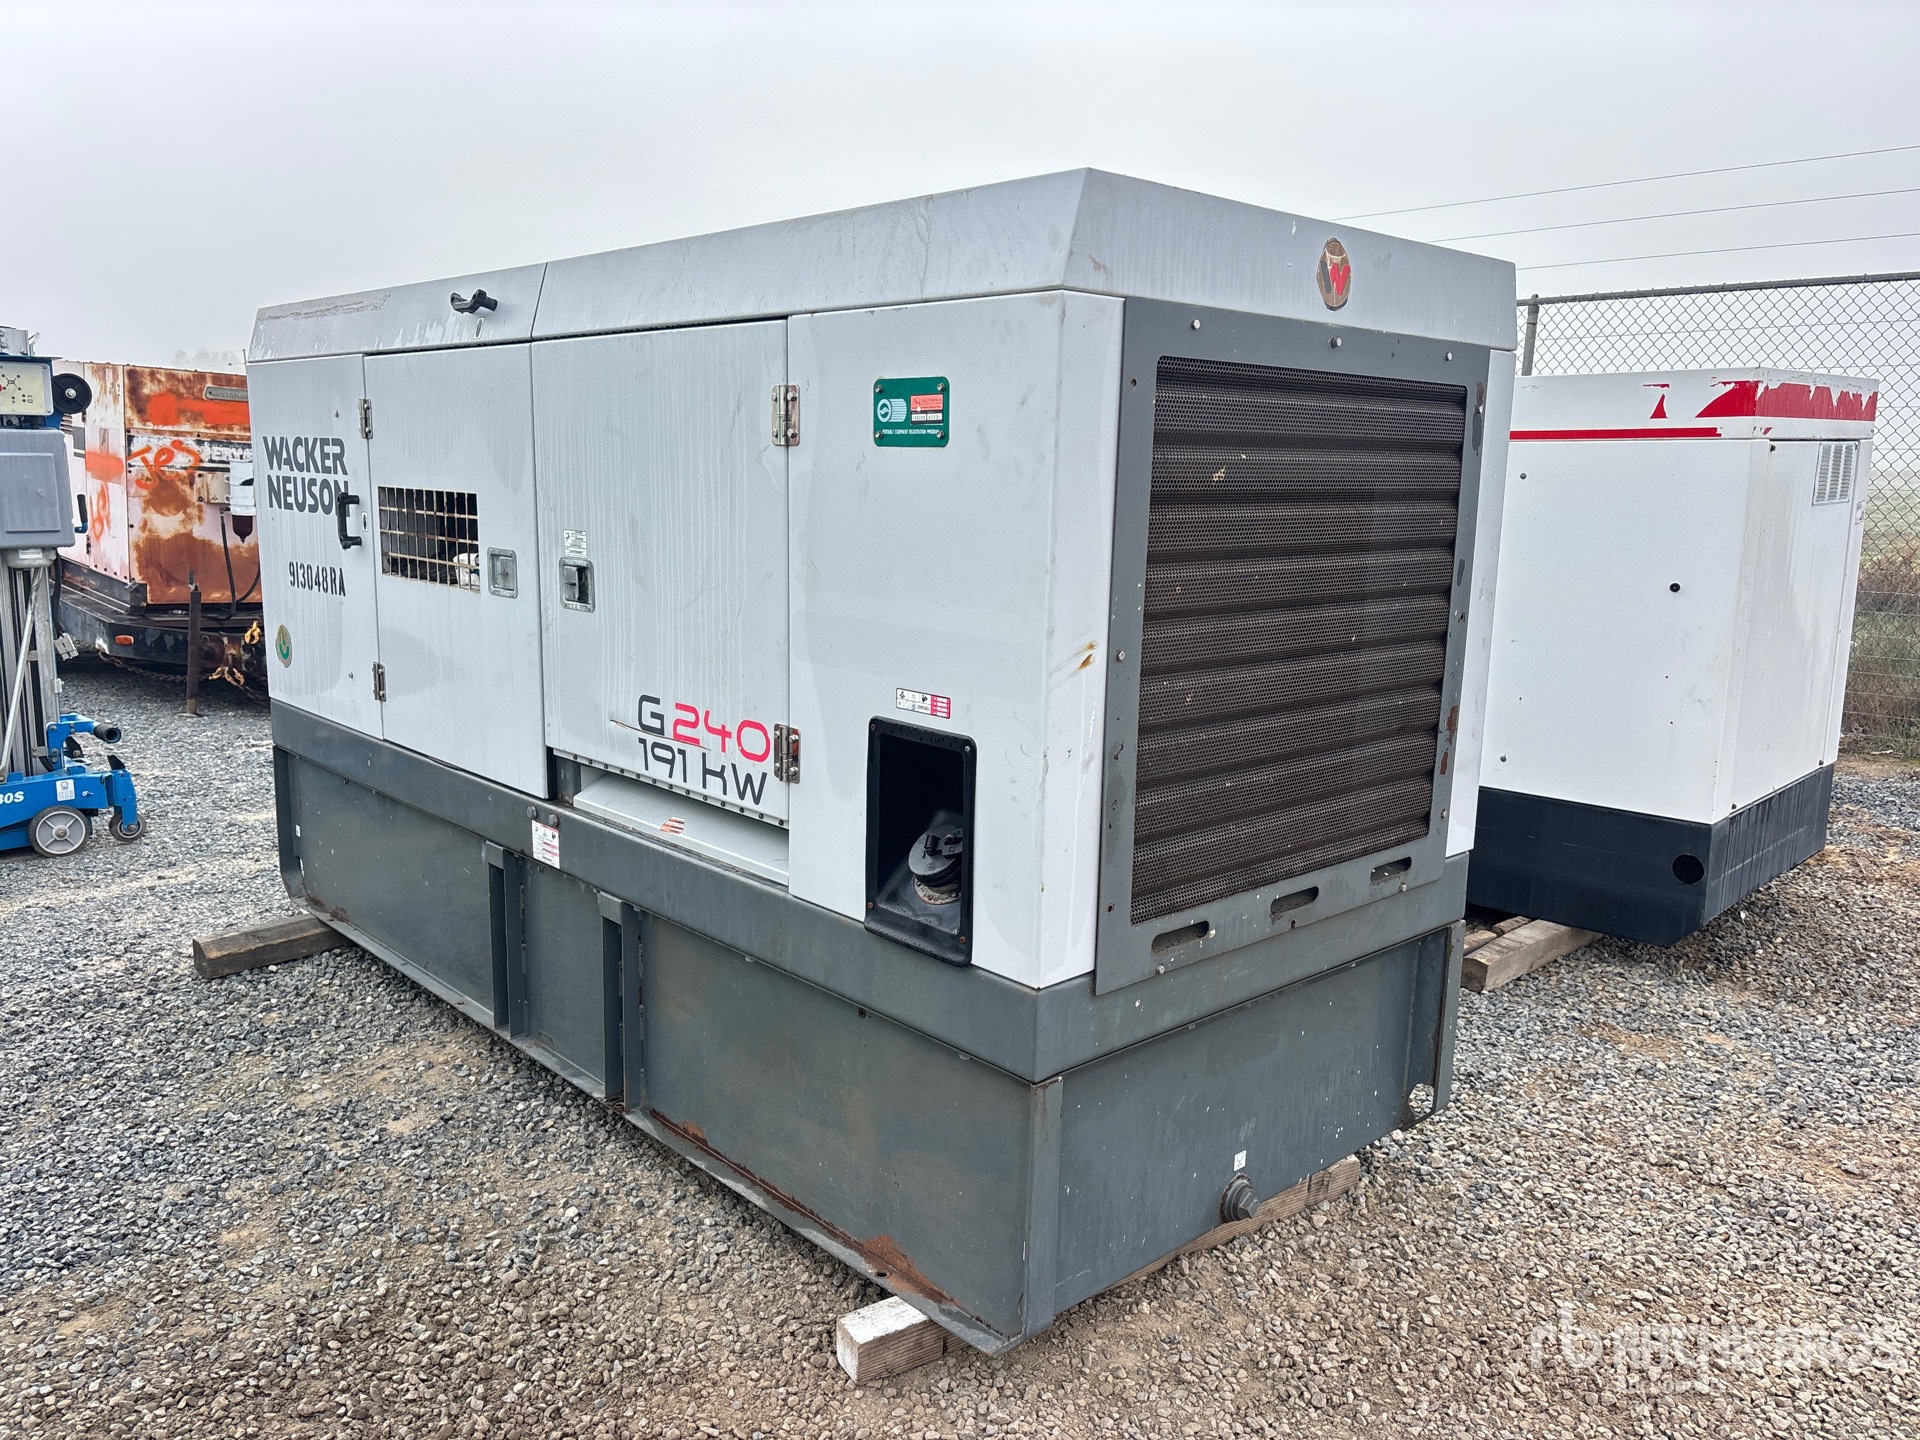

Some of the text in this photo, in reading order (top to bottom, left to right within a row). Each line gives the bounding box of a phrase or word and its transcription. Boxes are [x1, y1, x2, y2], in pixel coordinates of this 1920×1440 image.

[262, 436, 348, 475] WACKER
[267, 474, 350, 518] NEUSON
[638, 694, 771, 763] G240
[638, 737, 687, 783] 191
